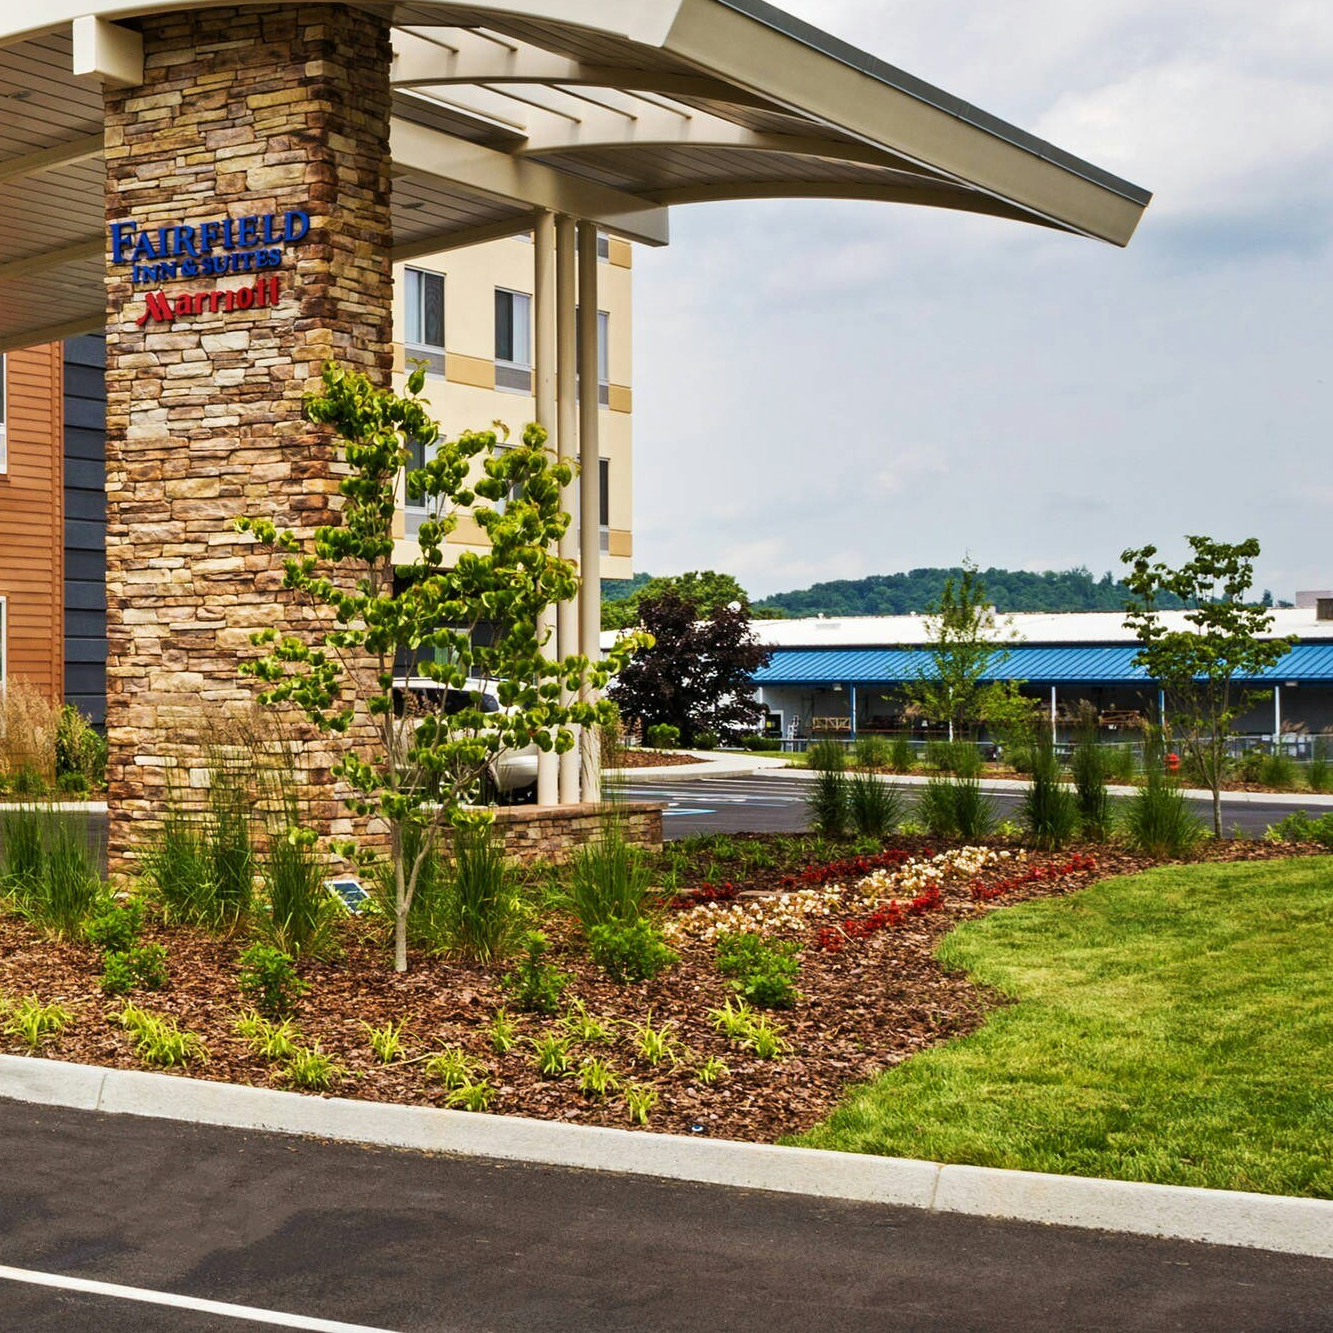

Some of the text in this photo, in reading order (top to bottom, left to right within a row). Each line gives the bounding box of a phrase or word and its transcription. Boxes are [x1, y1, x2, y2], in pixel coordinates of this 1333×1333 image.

[109, 210, 311, 265] FAIRFIELD
[132, 248, 282, 284] INN & SUITES
[135, 276, 281, 326] Marriott
